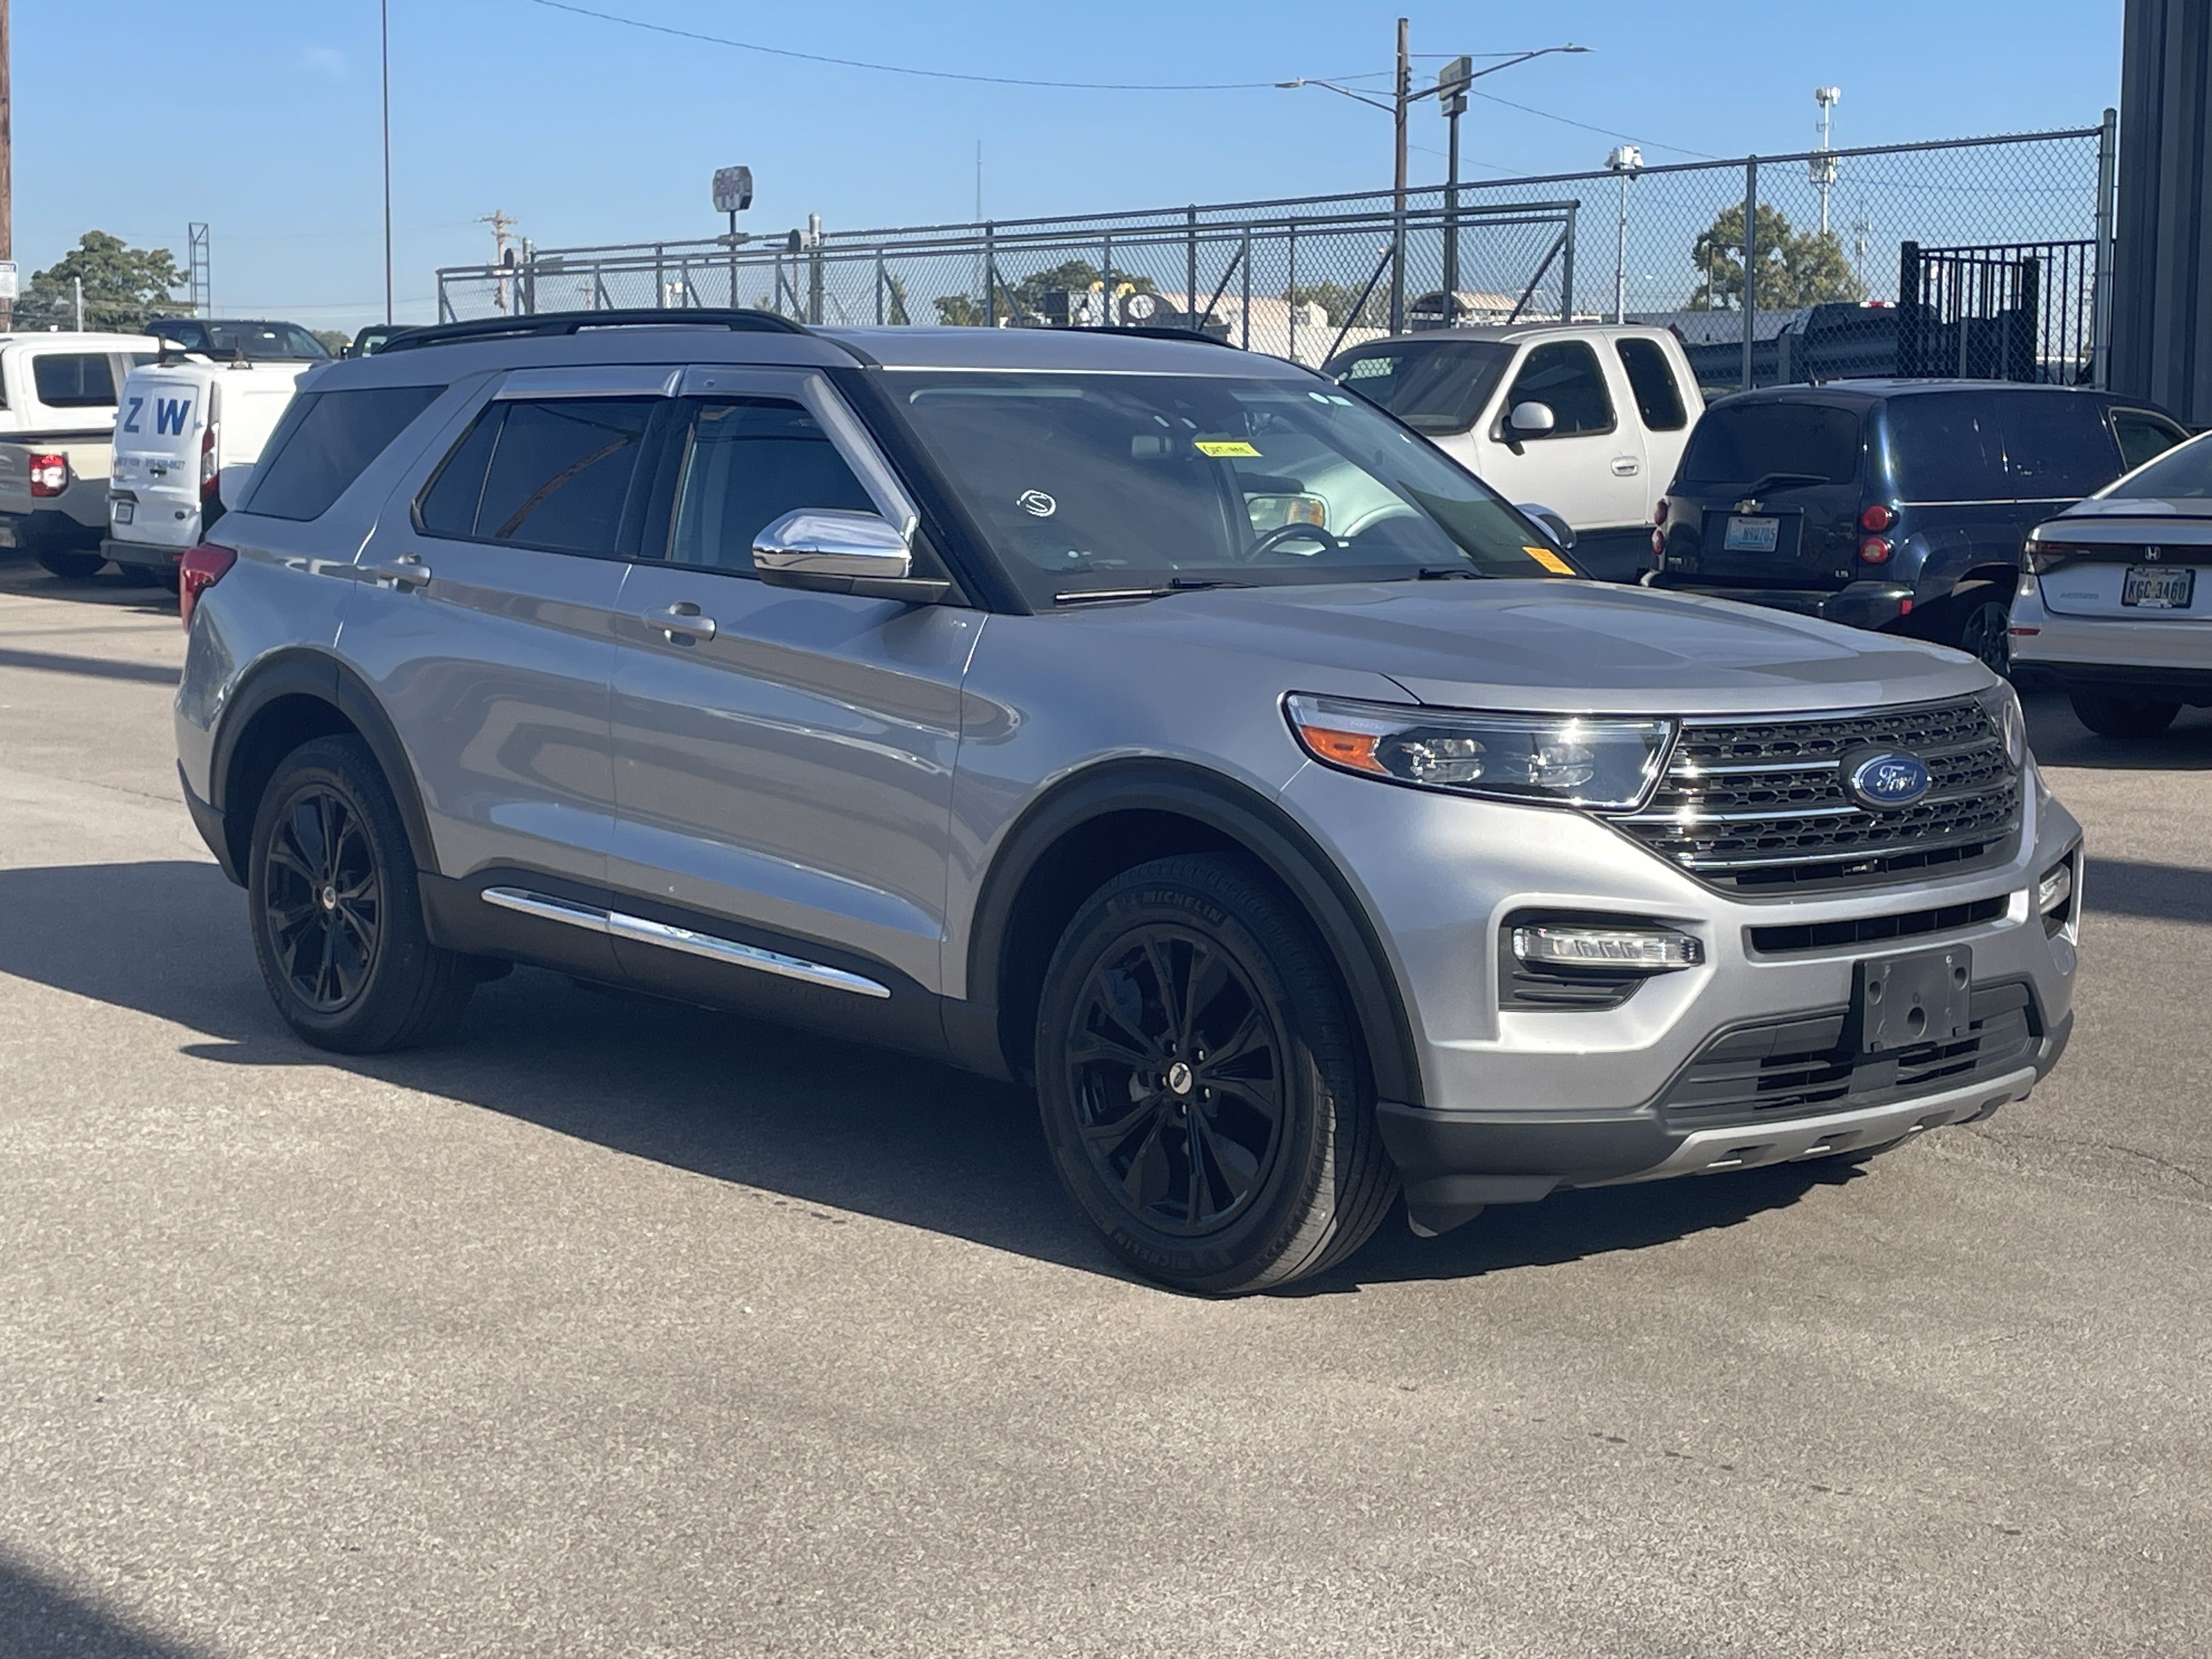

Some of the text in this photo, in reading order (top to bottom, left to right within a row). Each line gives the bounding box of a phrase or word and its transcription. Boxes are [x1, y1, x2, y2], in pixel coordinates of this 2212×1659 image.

[123, 397, 191, 436] Z W
[2128, 580, 2186, 600] KGC 3460
[1877, 765, 1918, 793] Ford
[1142, 890, 1223, 923] MICHELIN
